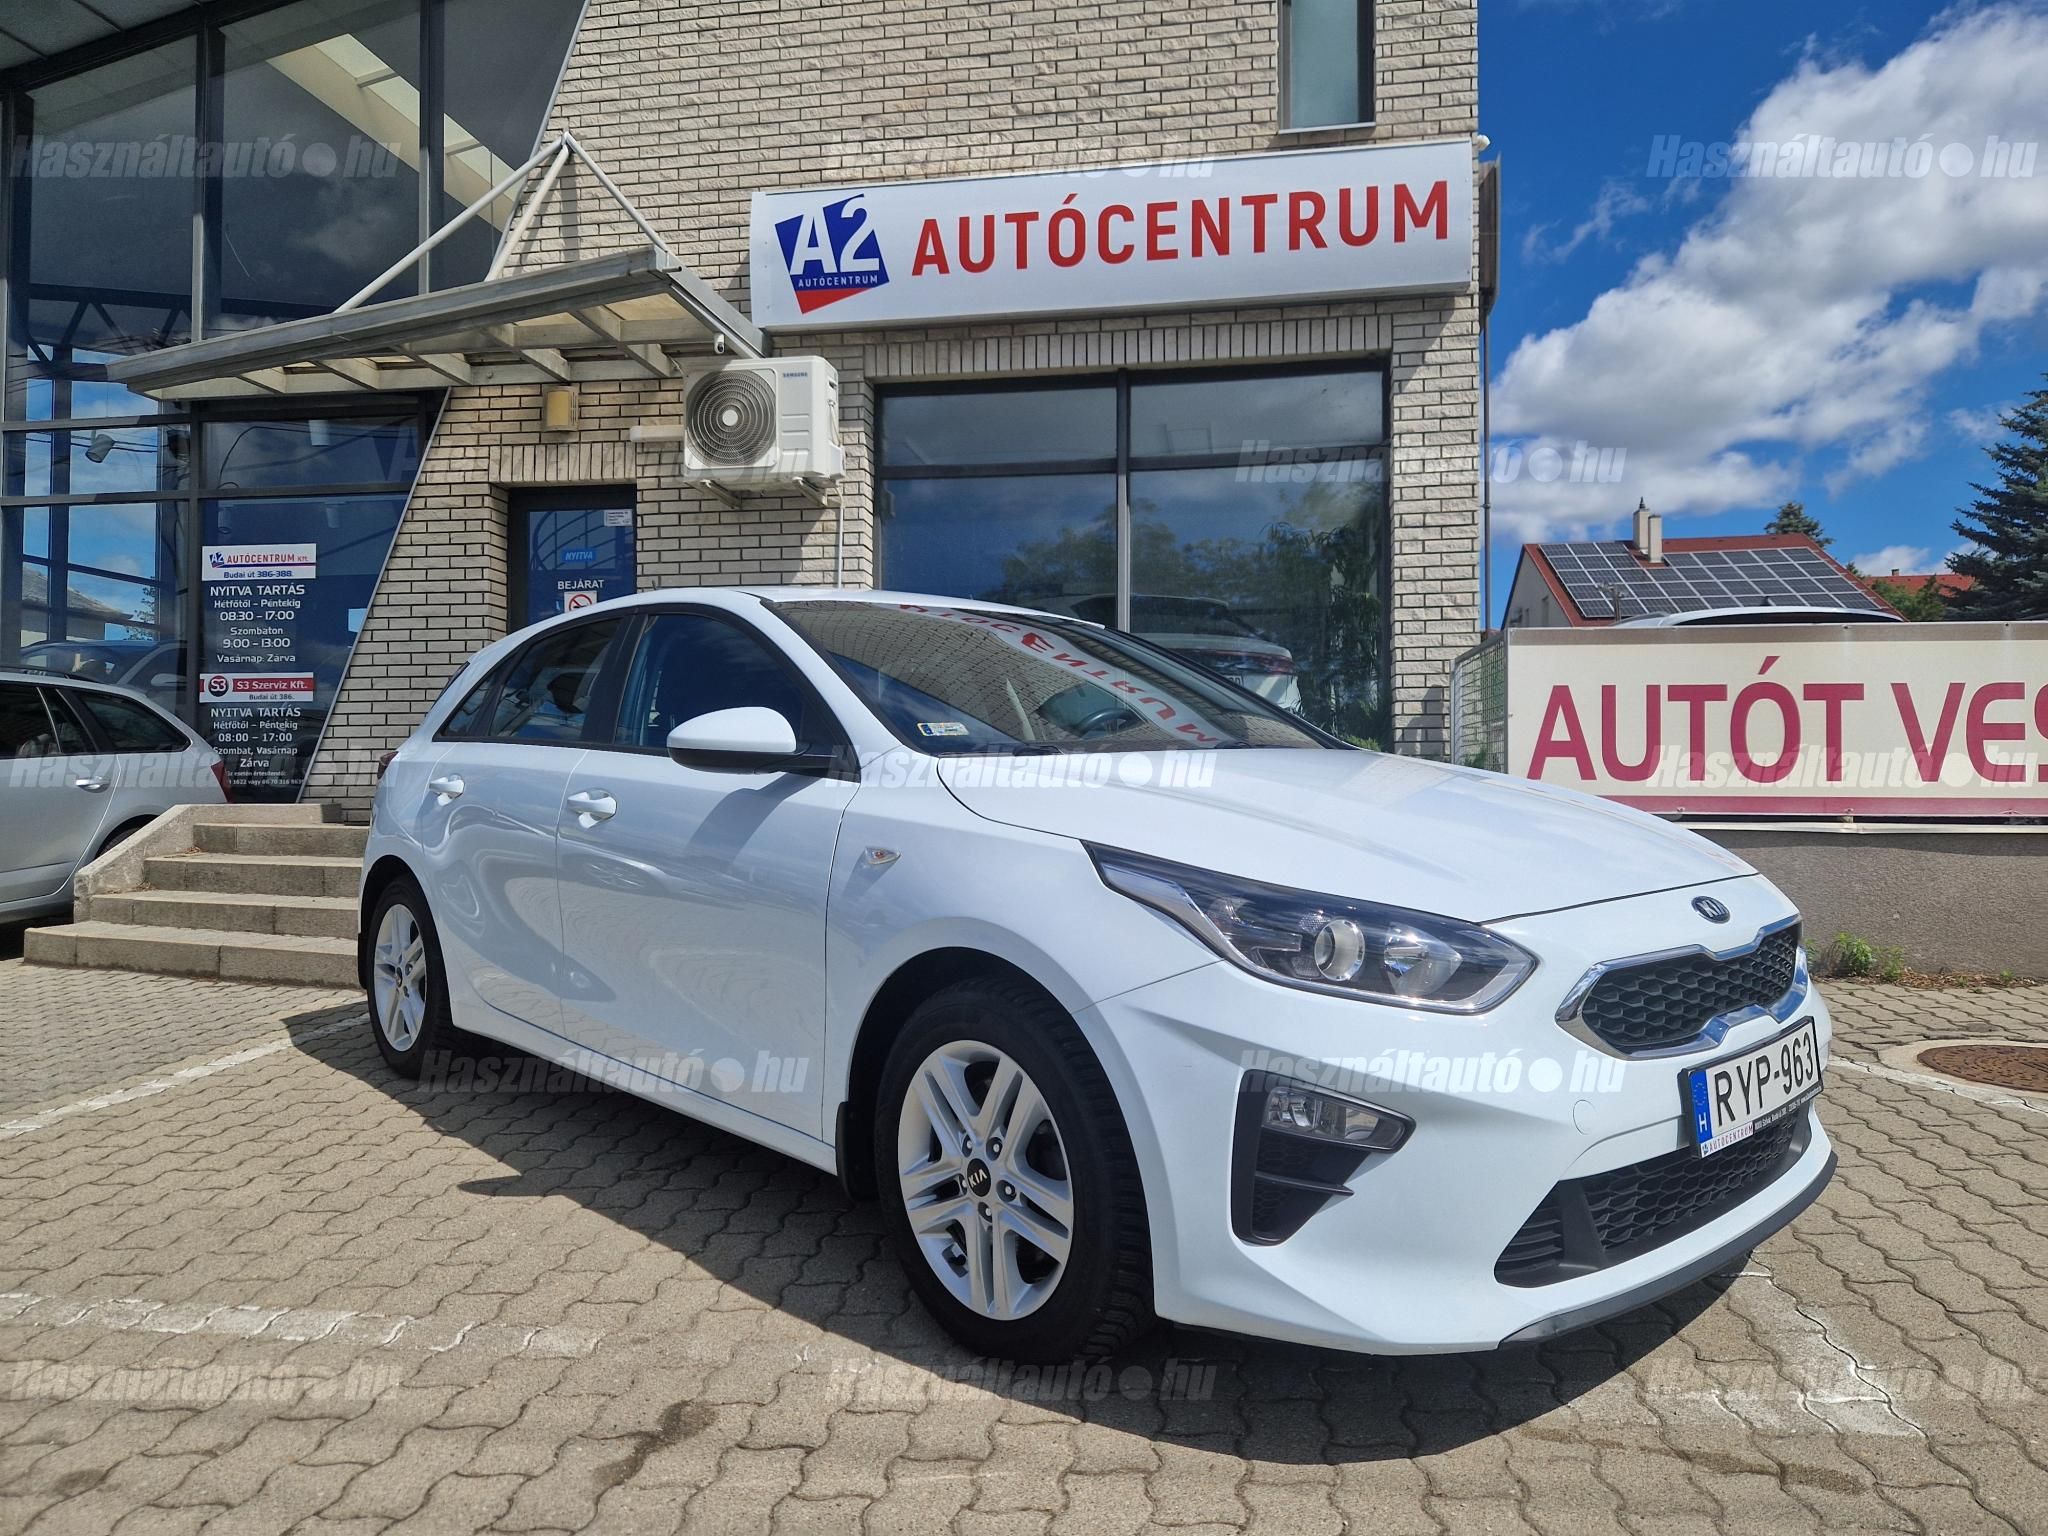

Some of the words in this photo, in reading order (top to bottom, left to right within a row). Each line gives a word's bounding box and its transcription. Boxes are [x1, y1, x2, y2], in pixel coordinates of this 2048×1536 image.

[911, 180, 1448, 276] AUTÓCENTRUM
[790, 196, 880, 276] A2
[798, 274, 878, 288] AUTÓCENTRUM
[227, 553, 295, 564] AUTÓCENTRUM
[565, 551, 593, 561] NYITVA
[223, 571, 246, 579] Budai
[210, 586, 253, 596] NYITVA
[257, 582, 305, 596] TARTÁS
[557, 578, 605, 590] BEJÁRAT
[214, 600, 251, 609] Hétfőtől
[260, 599, 301, 609] Péntekig
[220, 611, 254, 621] 08:30
[265, 610, 295, 621] 17:00
[230, 626, 284, 636] Szombaton
[222, 638, 250, 648] 9:00
[261, 637, 291, 648] 13:00
[267, 653, 296, 662] Zárva
[210, 678, 227, 692] S3
[237, 681, 249, 690] S3
[252, 680, 289, 690] Szerviz
[290, 679, 308, 690] Kft.
[211, 708, 253, 718] NYITVA
[257, 704, 301, 717] TARTÁS
[1526, 655, 1865, 782] AUTÓT
[213, 721, 249, 729] Hétfőtől
[259, 720, 298, 730] Péntekig
[218, 733, 249, 742] 08:00
[262, 732, 292, 742] 17:00
[213, 746, 254, 756] Szombat,
[256, 746, 298, 756] Vasárnap
[240, 757, 270, 768] Zárva
[1714, 1032, 1814, 1127] RYP-963
[1698, 1112, 1708, 1133] H
[969, 1168, 988, 1188] KIA
